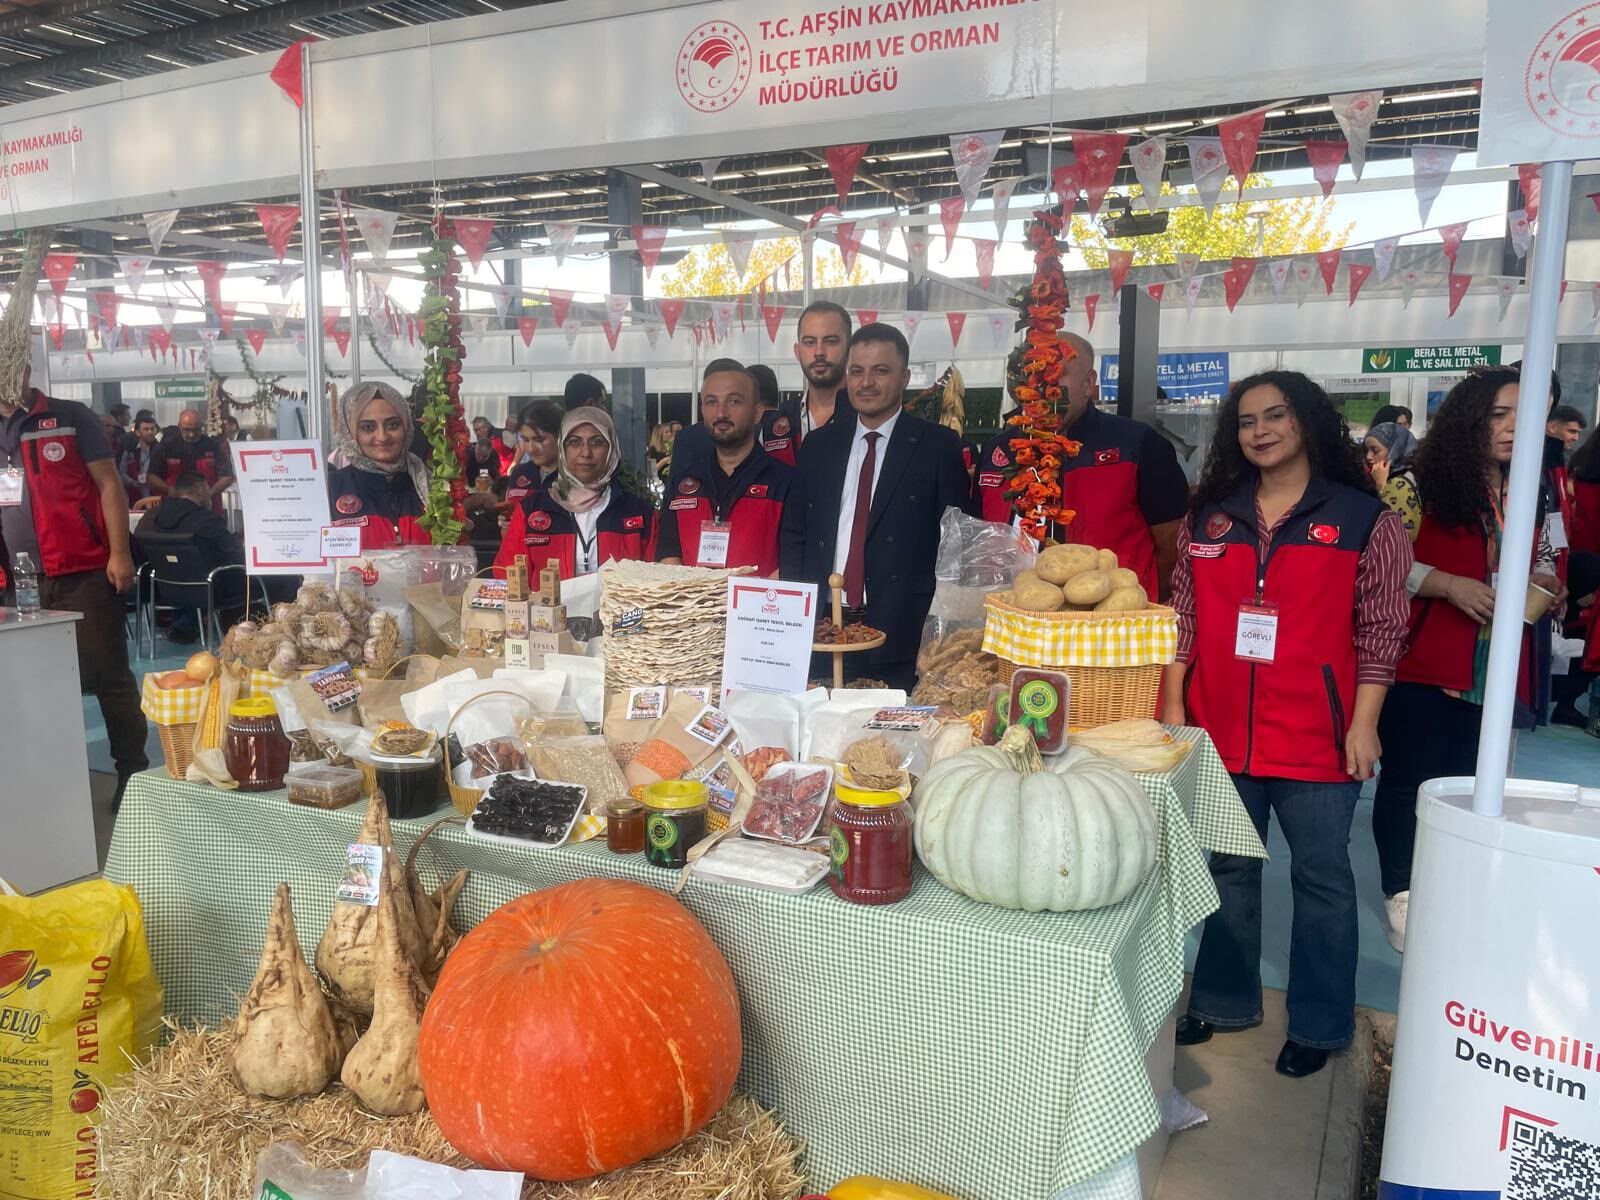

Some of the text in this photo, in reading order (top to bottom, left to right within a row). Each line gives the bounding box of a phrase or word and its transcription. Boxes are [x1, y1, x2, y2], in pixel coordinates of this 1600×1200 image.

[759, 18, 795, 40] T.C.
[799, 6, 862, 36] AFŞİN
[759, 22, 1000, 76] İLÇE TARIM VE ORMAN
[758, 66, 898, 106] MÜDÜRLÜĞÜ
[4, 126, 82, 155] KAYMAKAMLIĞI
[11, 158, 49, 177] ORMAN
[1405, 357, 1421, 369] TİC.
[1422, 359, 1433, 368] VE
[1434, 358, 1454, 369] SAN.
[1455, 357, 1473, 368] LTD.
[1414, 346, 1482, 358] BERA TEL METAL
[1177, 363, 1185, 374] &
[1187, 360, 1224, 374] METAL
[1241, 631, 1272, 641] GÖREVLİ
[0, 1009, 41, 1036] ELLO
[1445, 1000, 1600, 1073] Güvenili
[1455, 1037, 1587, 1101] Denetim
